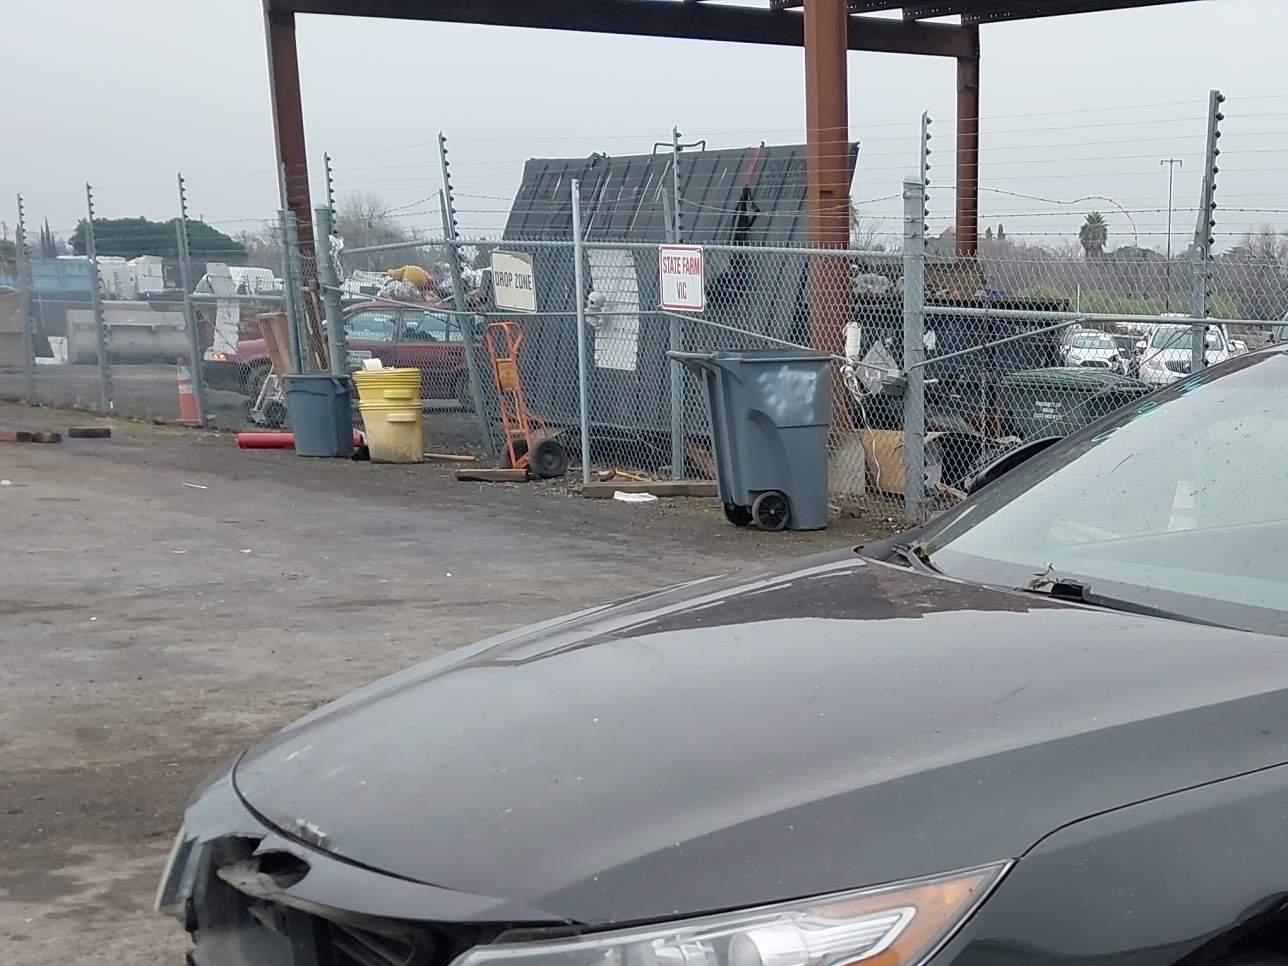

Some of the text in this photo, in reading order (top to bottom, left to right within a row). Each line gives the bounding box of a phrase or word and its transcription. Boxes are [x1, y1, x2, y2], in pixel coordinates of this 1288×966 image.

[662, 255, 700, 275] STATE FARM
[494, 270, 532, 290] DROP ZONE
[676, 281, 687, 300] VIC
